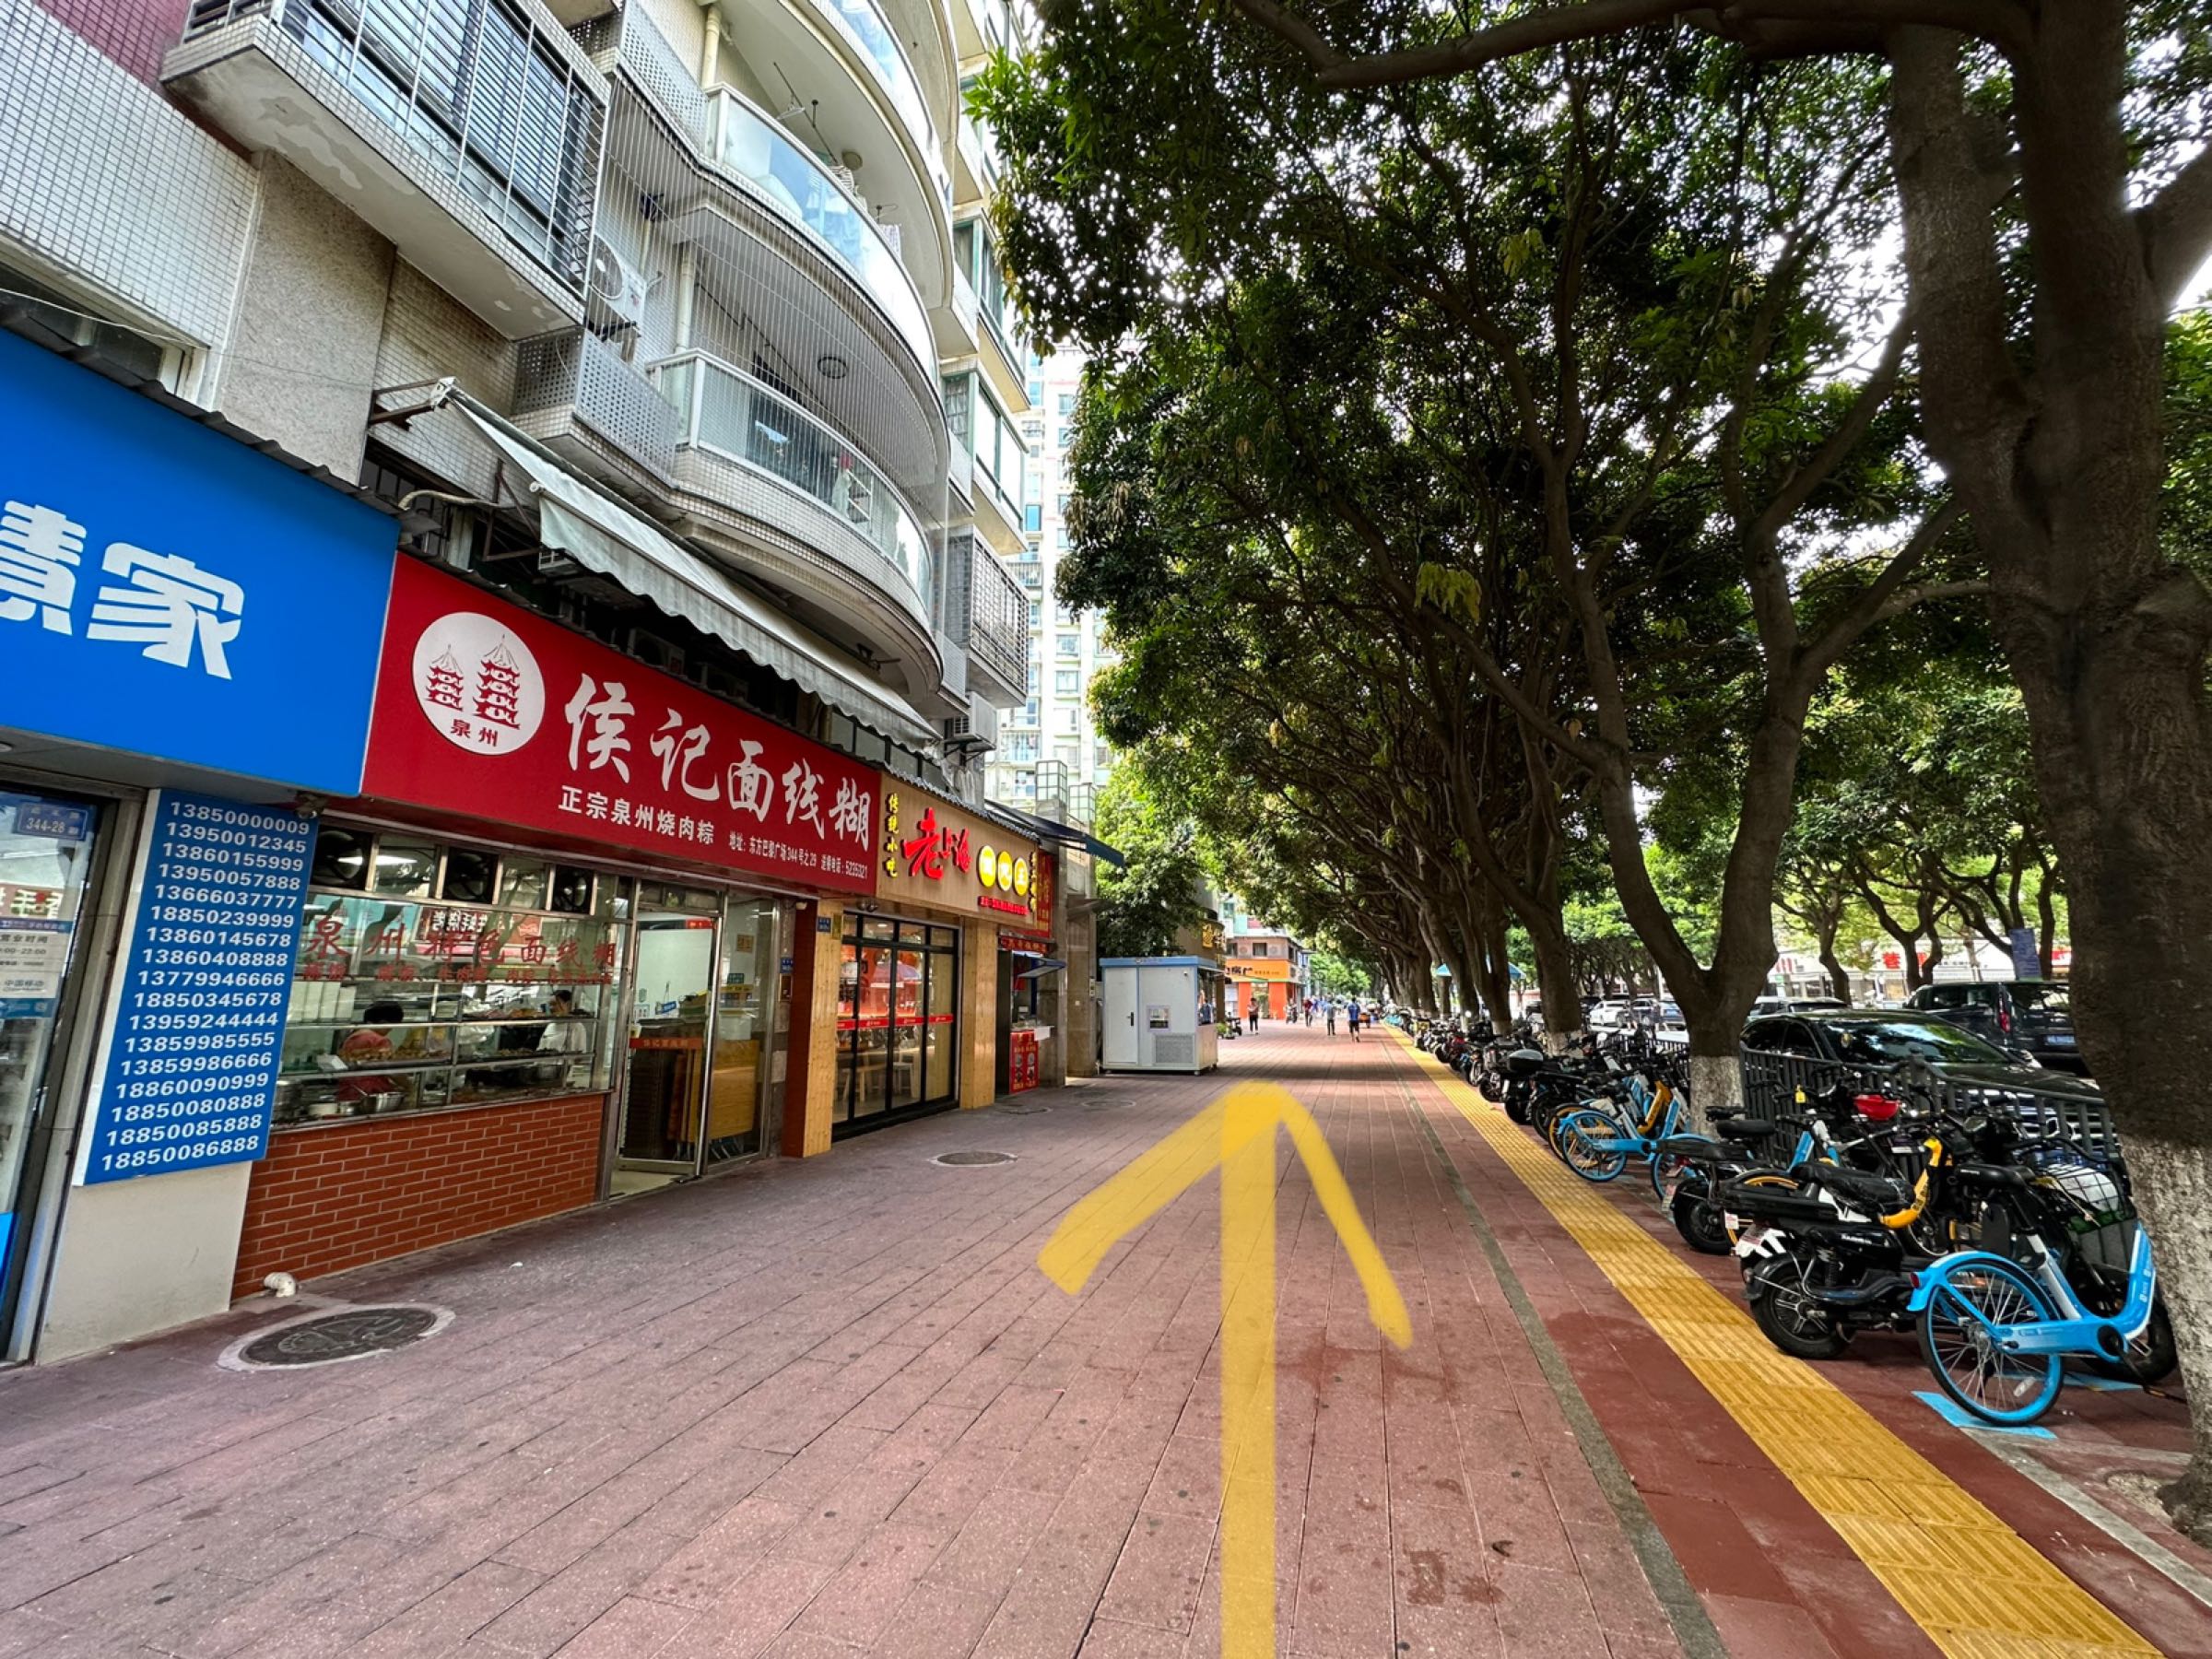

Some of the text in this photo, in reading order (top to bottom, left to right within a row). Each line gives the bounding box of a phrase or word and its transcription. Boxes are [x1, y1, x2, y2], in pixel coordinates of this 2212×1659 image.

[450, 719, 499, 747] 泉州
[565, 673, 870, 853] 侯记面线糊
[171, 802, 310, 835] 13850000009
[559, 784, 716, 845] 正宗泉州烧肉粽
[167, 822, 307, 853] 13950012345
[163, 843, 303, 872] 13860155999
[159, 864, 300, 890] 13950057888
[155, 885, 297, 909] 13666037777
[151, 905, 294, 928] 18850239999
[147, 927, 290, 947] 13860145678
[305, 915, 617, 968] 泉州特色面线糊
[143, 948, 288, 966] 13860408888
[138, 971, 285, 986] 13779946666
[134, 993, 281, 1007] 18850345678
[129, 1012, 278, 1030] 13959244444
[125, 1032, 275, 1053] 13859985555
[121, 1052, 272, 1076] 13859986666
[116, 1073, 268, 1099] 18860090999
[112, 1093, 265, 1123] 18850080888
[106, 1114, 262, 1147] 18850085888
[101, 1135, 259, 1171] 18850086888
